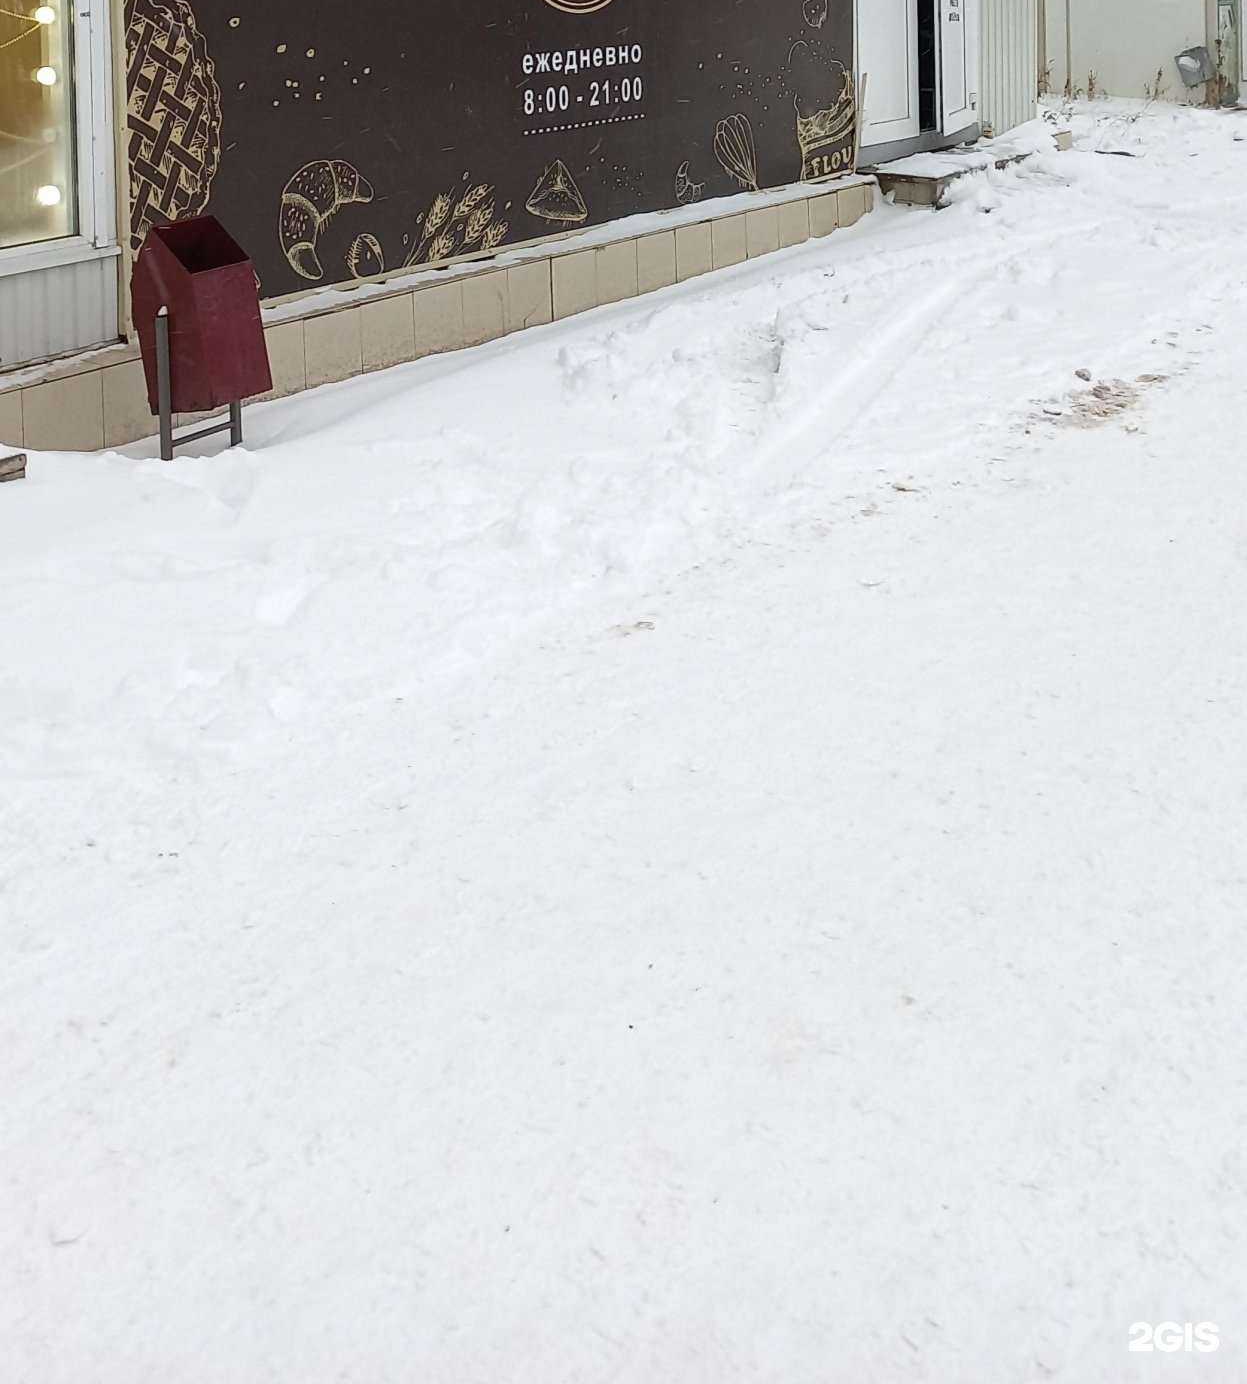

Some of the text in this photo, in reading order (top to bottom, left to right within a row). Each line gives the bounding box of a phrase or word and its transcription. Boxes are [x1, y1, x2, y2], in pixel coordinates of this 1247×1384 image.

[522, 44, 642, 75] ежедневно
[524, 85, 569, 115] 8:00
[589, 77, 642, 107] 21:00
